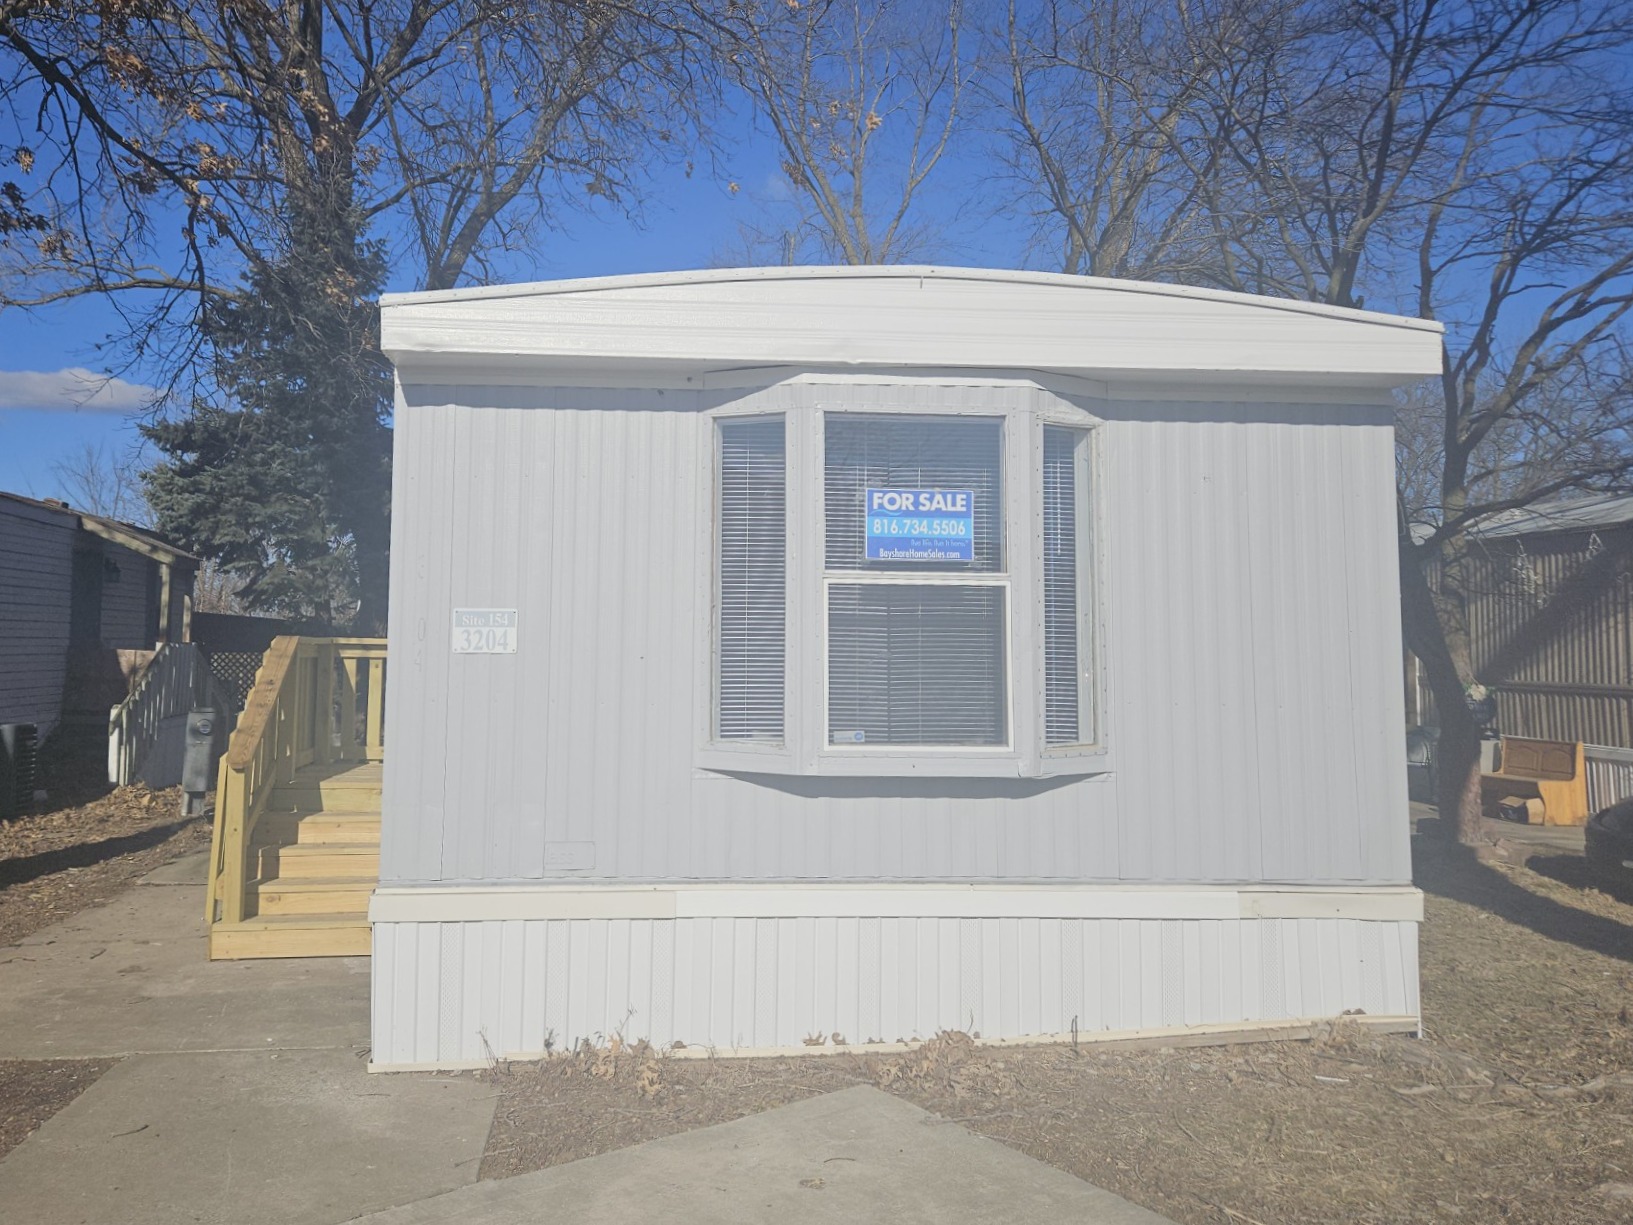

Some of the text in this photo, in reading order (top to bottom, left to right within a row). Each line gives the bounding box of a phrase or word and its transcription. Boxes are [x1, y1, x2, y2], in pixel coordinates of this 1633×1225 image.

[873, 492, 967, 512] FOR SALE
[873, 519, 966, 536] 816.734.5506
[879, 548, 960, 559] BayshoreHomeSales.com
[462, 613, 509, 626] Site 154
[460, 628, 509, 651] 3204
